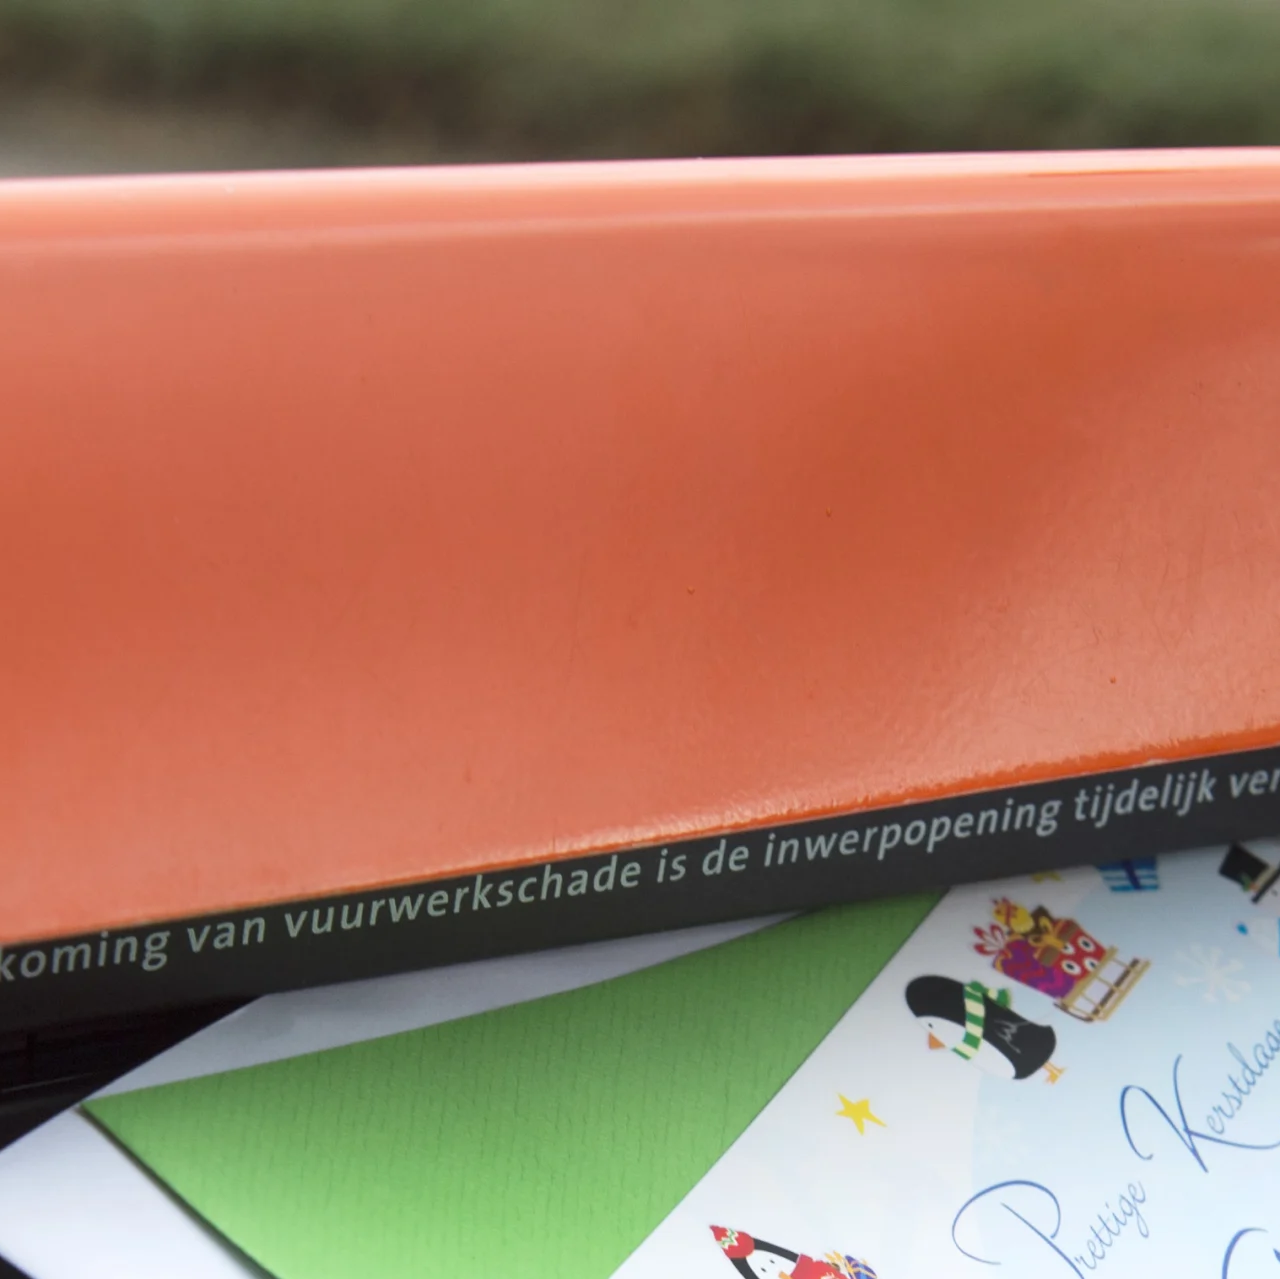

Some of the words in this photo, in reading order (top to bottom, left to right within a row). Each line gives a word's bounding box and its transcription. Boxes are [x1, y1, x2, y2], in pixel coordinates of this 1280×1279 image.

[186, 912, 267, 955] van
[284, 849, 642, 941] vuurwerkschade
[655, 846, 688, 884] is
[701, 839, 749, 876] de
[764, 795, 1062, 866] inwerpopening
[1073, 769, 1217, 825] tijdelijk
